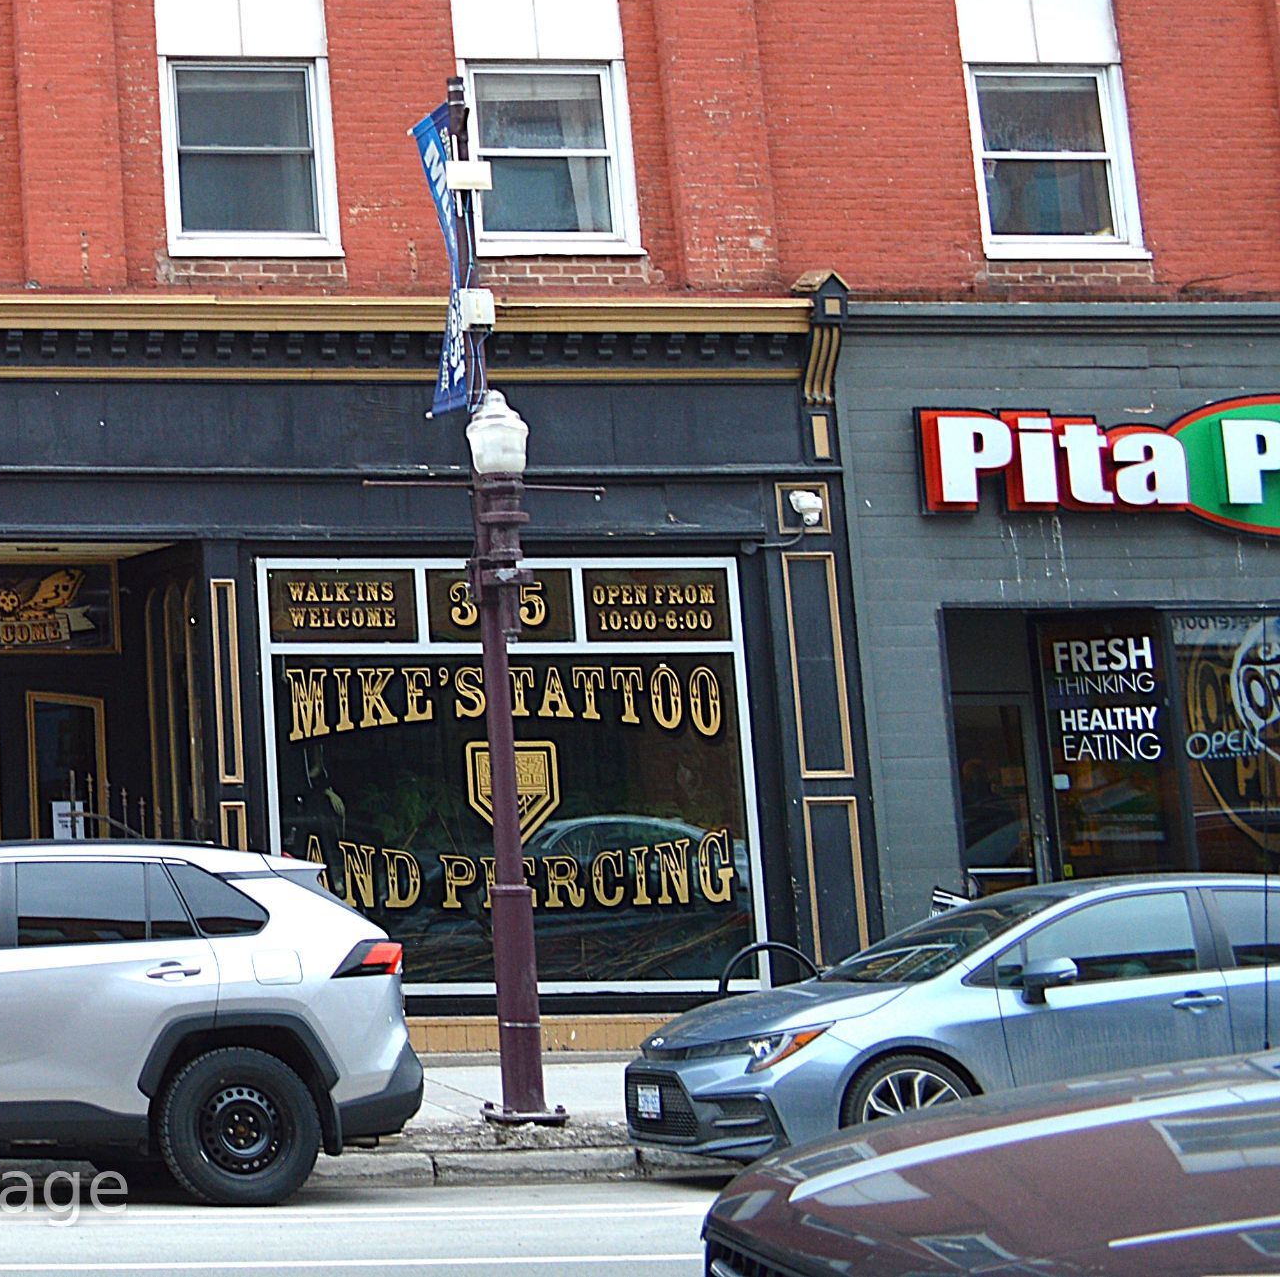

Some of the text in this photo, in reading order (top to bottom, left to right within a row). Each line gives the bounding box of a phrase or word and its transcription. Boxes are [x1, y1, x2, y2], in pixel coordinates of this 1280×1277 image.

[934, 414, 1192, 506] Pita
[287, 581, 395, 603] WALK-INS
[449, 580, 546, 627] 35
[592, 584, 716, 605] OPEN FROM
[288, 606, 397, 628] WELCOME
[1052, 635, 1154, 674] FRESH
[1053, 671, 1156, 697] THINKING
[285, 665, 723, 742] MIKE'S TATTOO
[1059, 705, 1158, 733] HEALTHY
[1061, 731, 1163, 764] EATING
